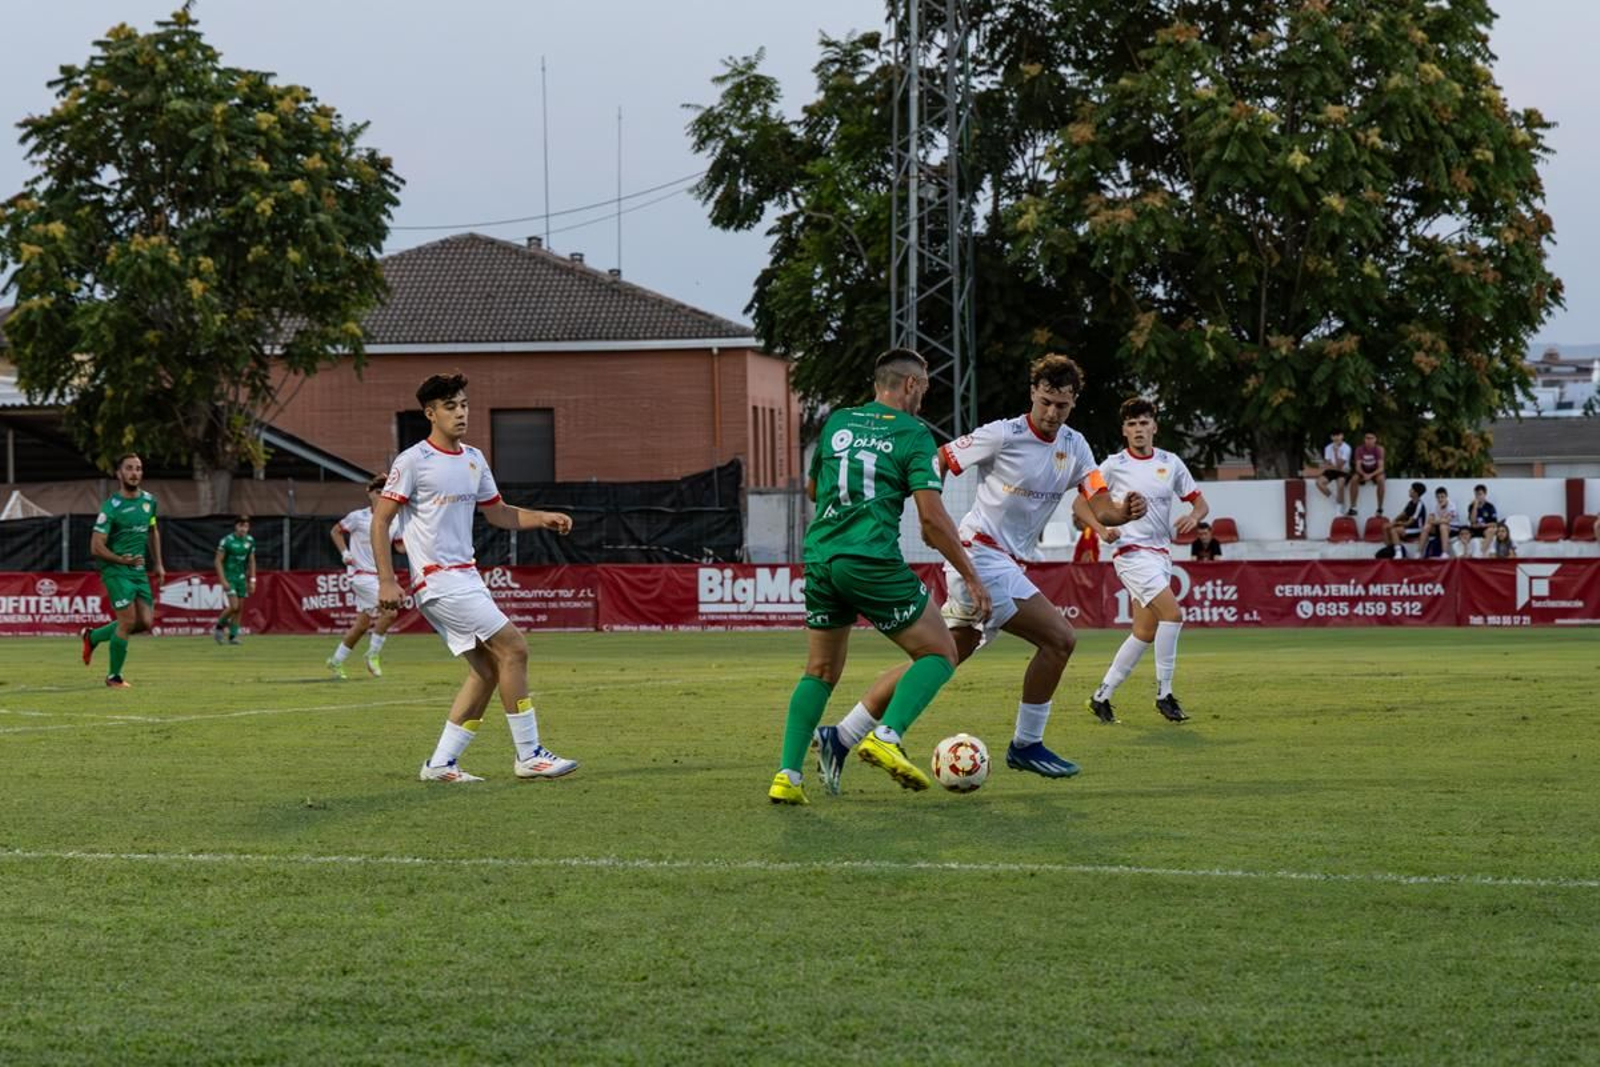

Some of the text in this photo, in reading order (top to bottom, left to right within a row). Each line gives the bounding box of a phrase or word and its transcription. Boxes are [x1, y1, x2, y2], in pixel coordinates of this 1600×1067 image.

[853, 438, 893, 452] OLMO
[834, 449, 877, 506] 11
[698, 568, 806, 612] BigMa
[1275, 578, 1444, 597] CERRAJERÍA METÁLICA
[302, 594, 343, 611] ANGEL
[1315, 602, 1422, 616] 635 459 512
